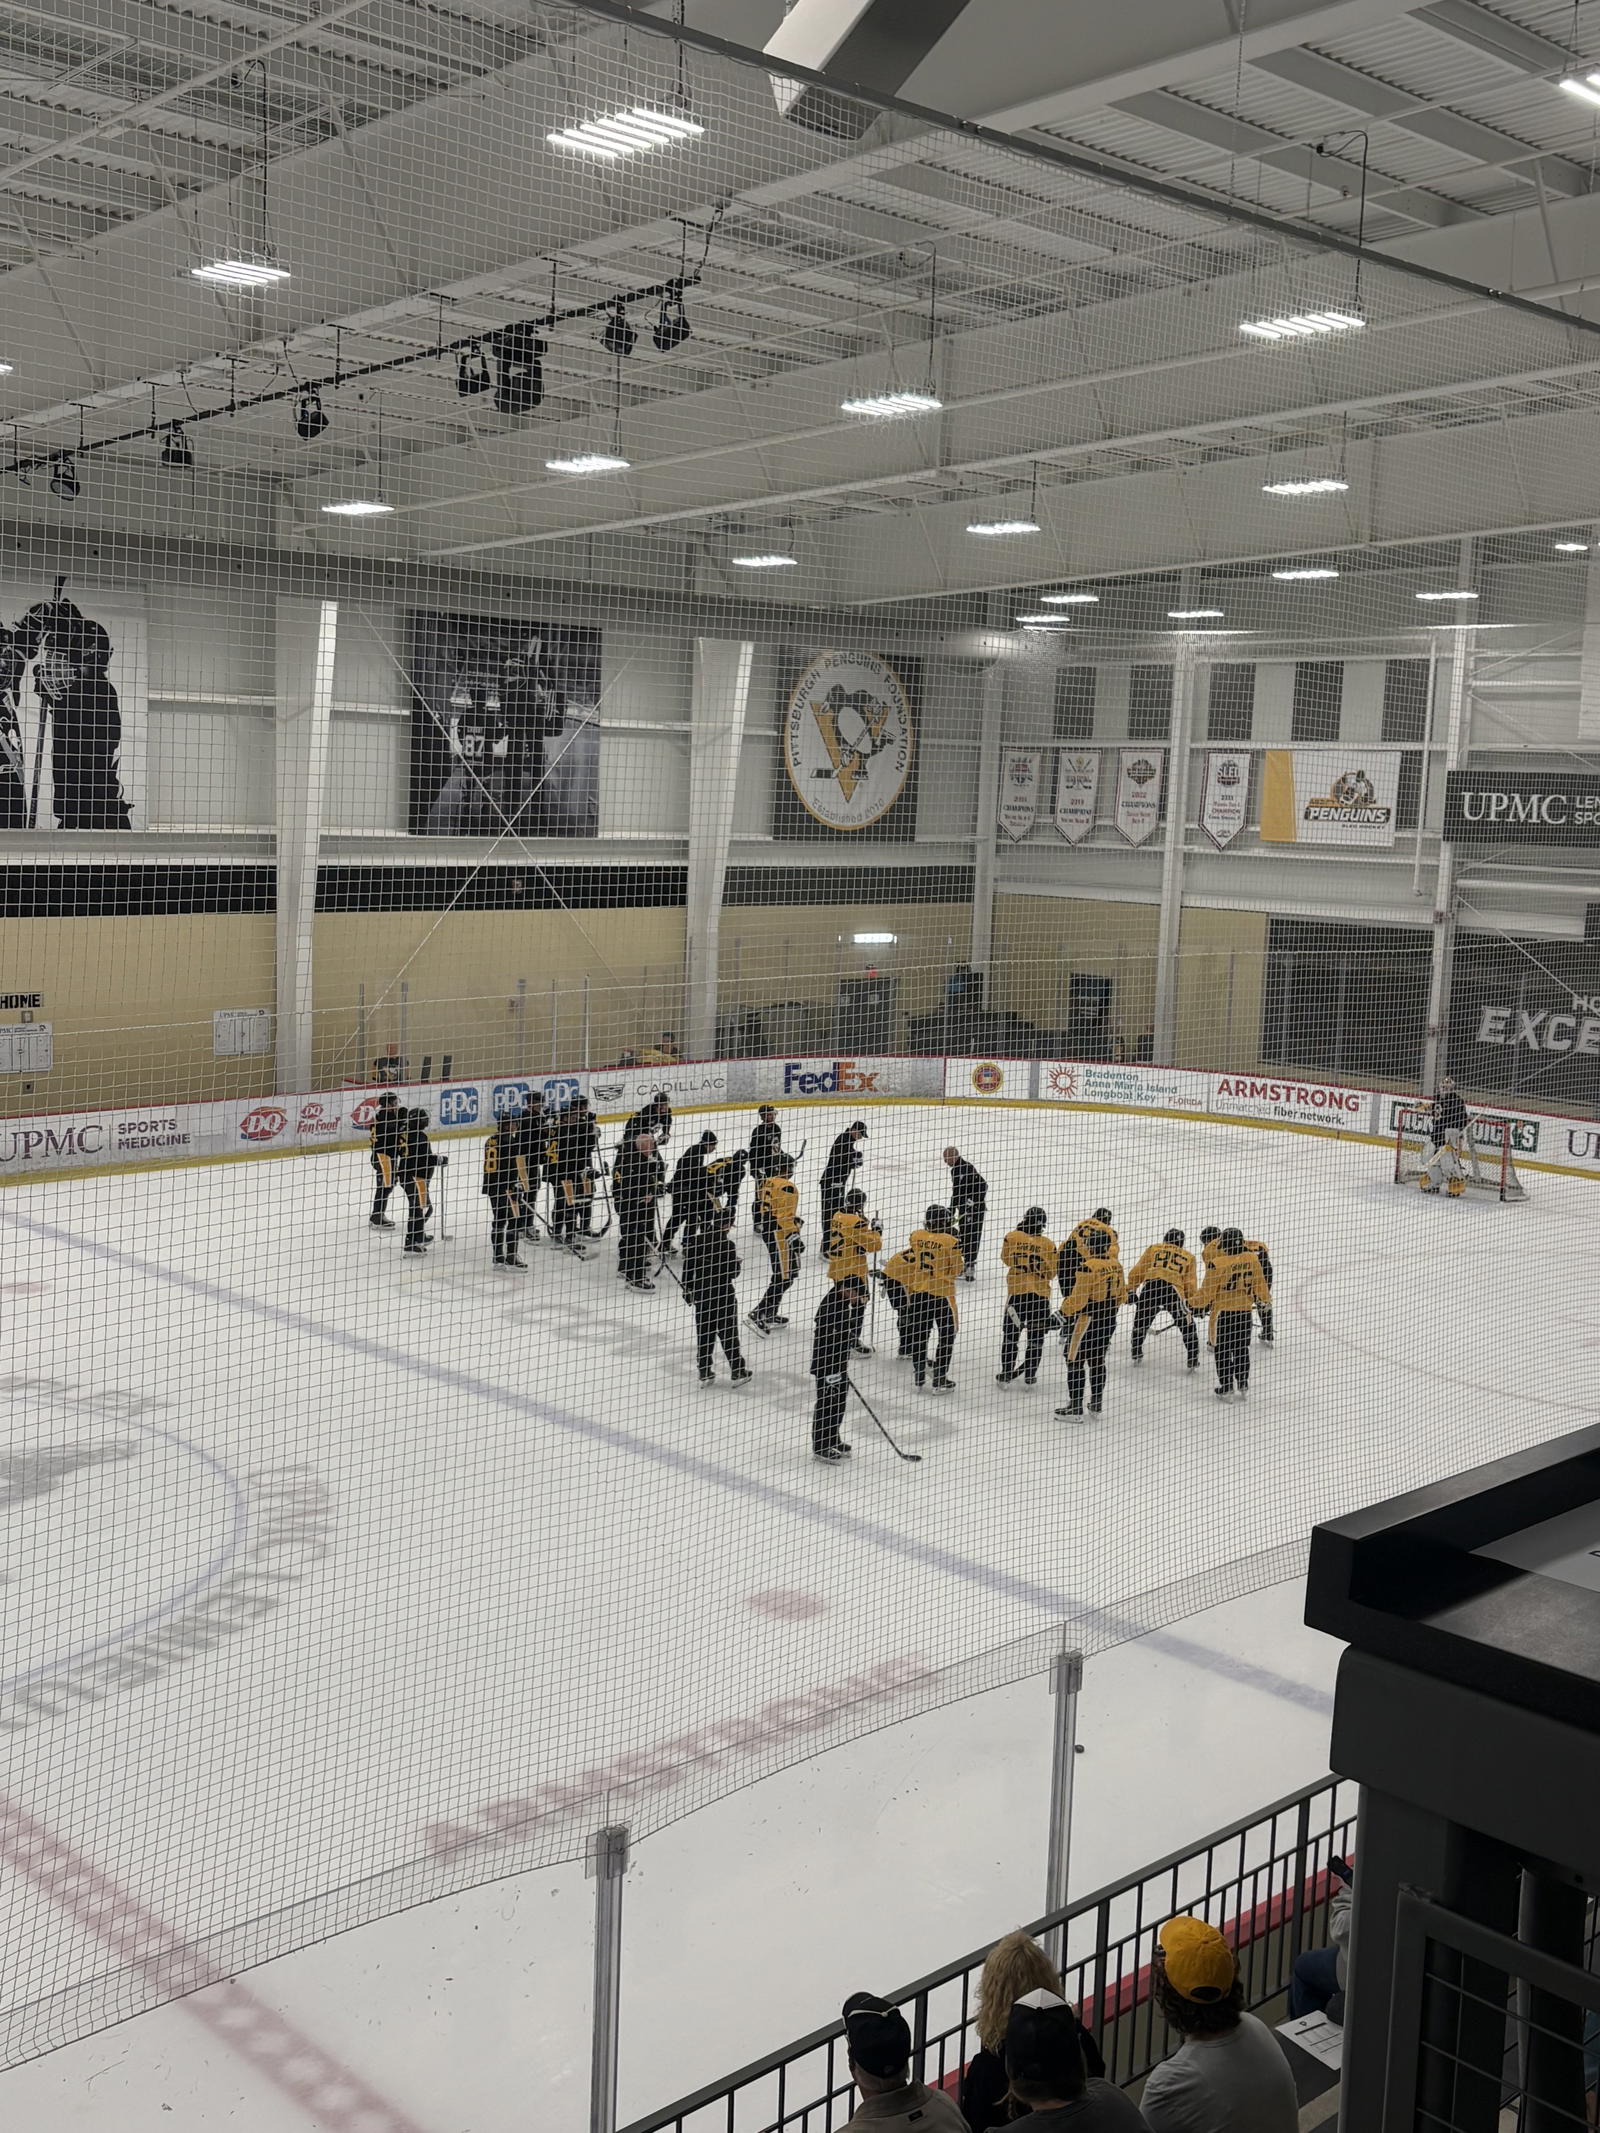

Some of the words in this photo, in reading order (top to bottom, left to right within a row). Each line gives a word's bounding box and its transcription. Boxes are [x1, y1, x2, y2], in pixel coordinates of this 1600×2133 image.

[790, 669, 821, 768] PITTSBURGH
[824, 652, 883, 675] PENGUINS
[1309, 807, 1387, 823] PENGUINS
[1461, 791, 1567, 824] UPMC
[0, 993, 41, 1009] HOME
[784, 1062, 880, 1094] FedEx
[1085, 1069, 1139, 1081] Bradenton
[637, 1078, 725, 1096] CADILLAC
[1084, 1079, 1111, 1089] Anna
[1114, 1081, 1143, 1091] Maria
[1147, 1083, 1178, 1095] Island
[1084, 1088, 1133, 1101] Longboat
[1137, 1092, 1156, 1103] Key
[1217, 1079, 1360, 1112] ARMSTRONG
[1168, 1097, 1202, 1107] FLORIDA
[1215, 1100, 1271, 1115] Unmatched
[1273, 1104, 1298, 1118] fiber
[1300, 1110, 1346, 1126] network.
[118, 1119, 178, 1135] SPORTS
[247, 1113, 281, 1133] DQ
[0, 1124, 103, 1162] UPMC
[118, 1133, 191, 1150] MEDICINE
